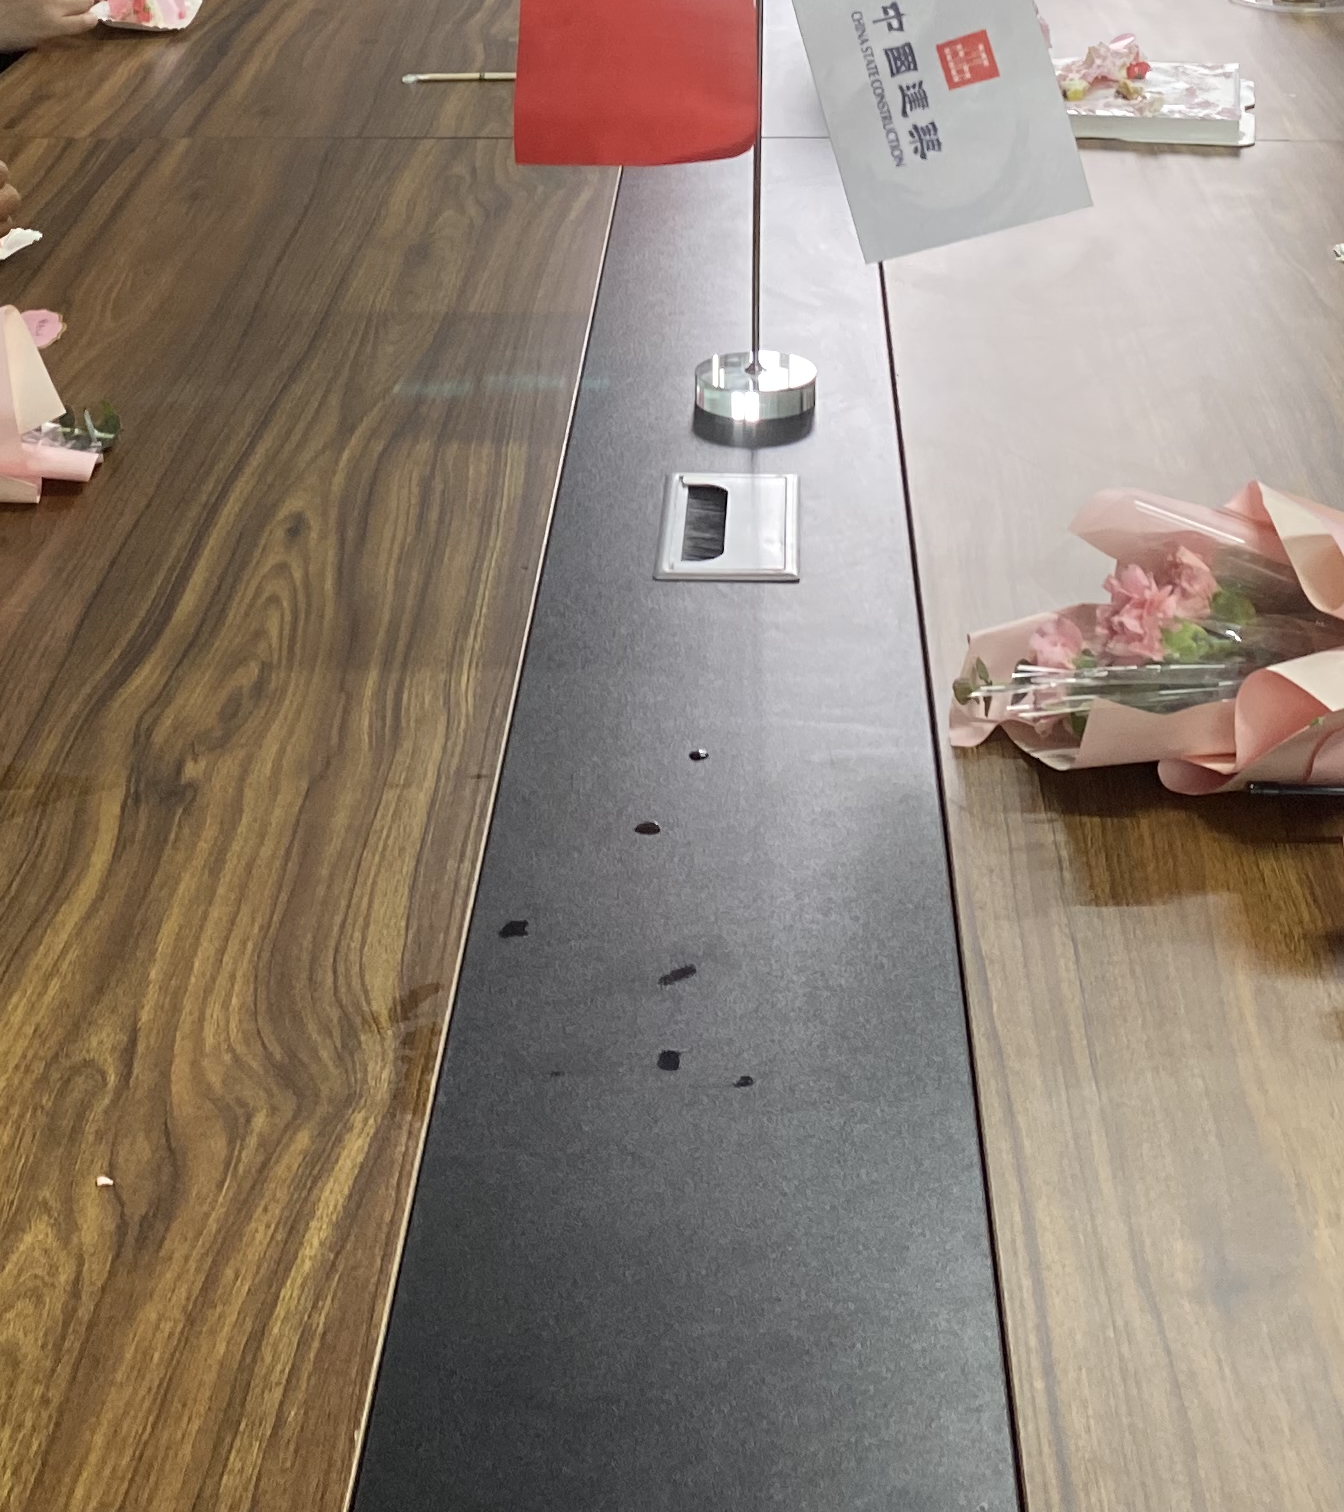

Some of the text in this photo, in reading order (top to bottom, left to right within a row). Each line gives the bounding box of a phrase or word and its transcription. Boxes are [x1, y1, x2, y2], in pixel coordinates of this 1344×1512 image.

[850, 10, 905, 168] CHINA STATE CONSTRUCTION
